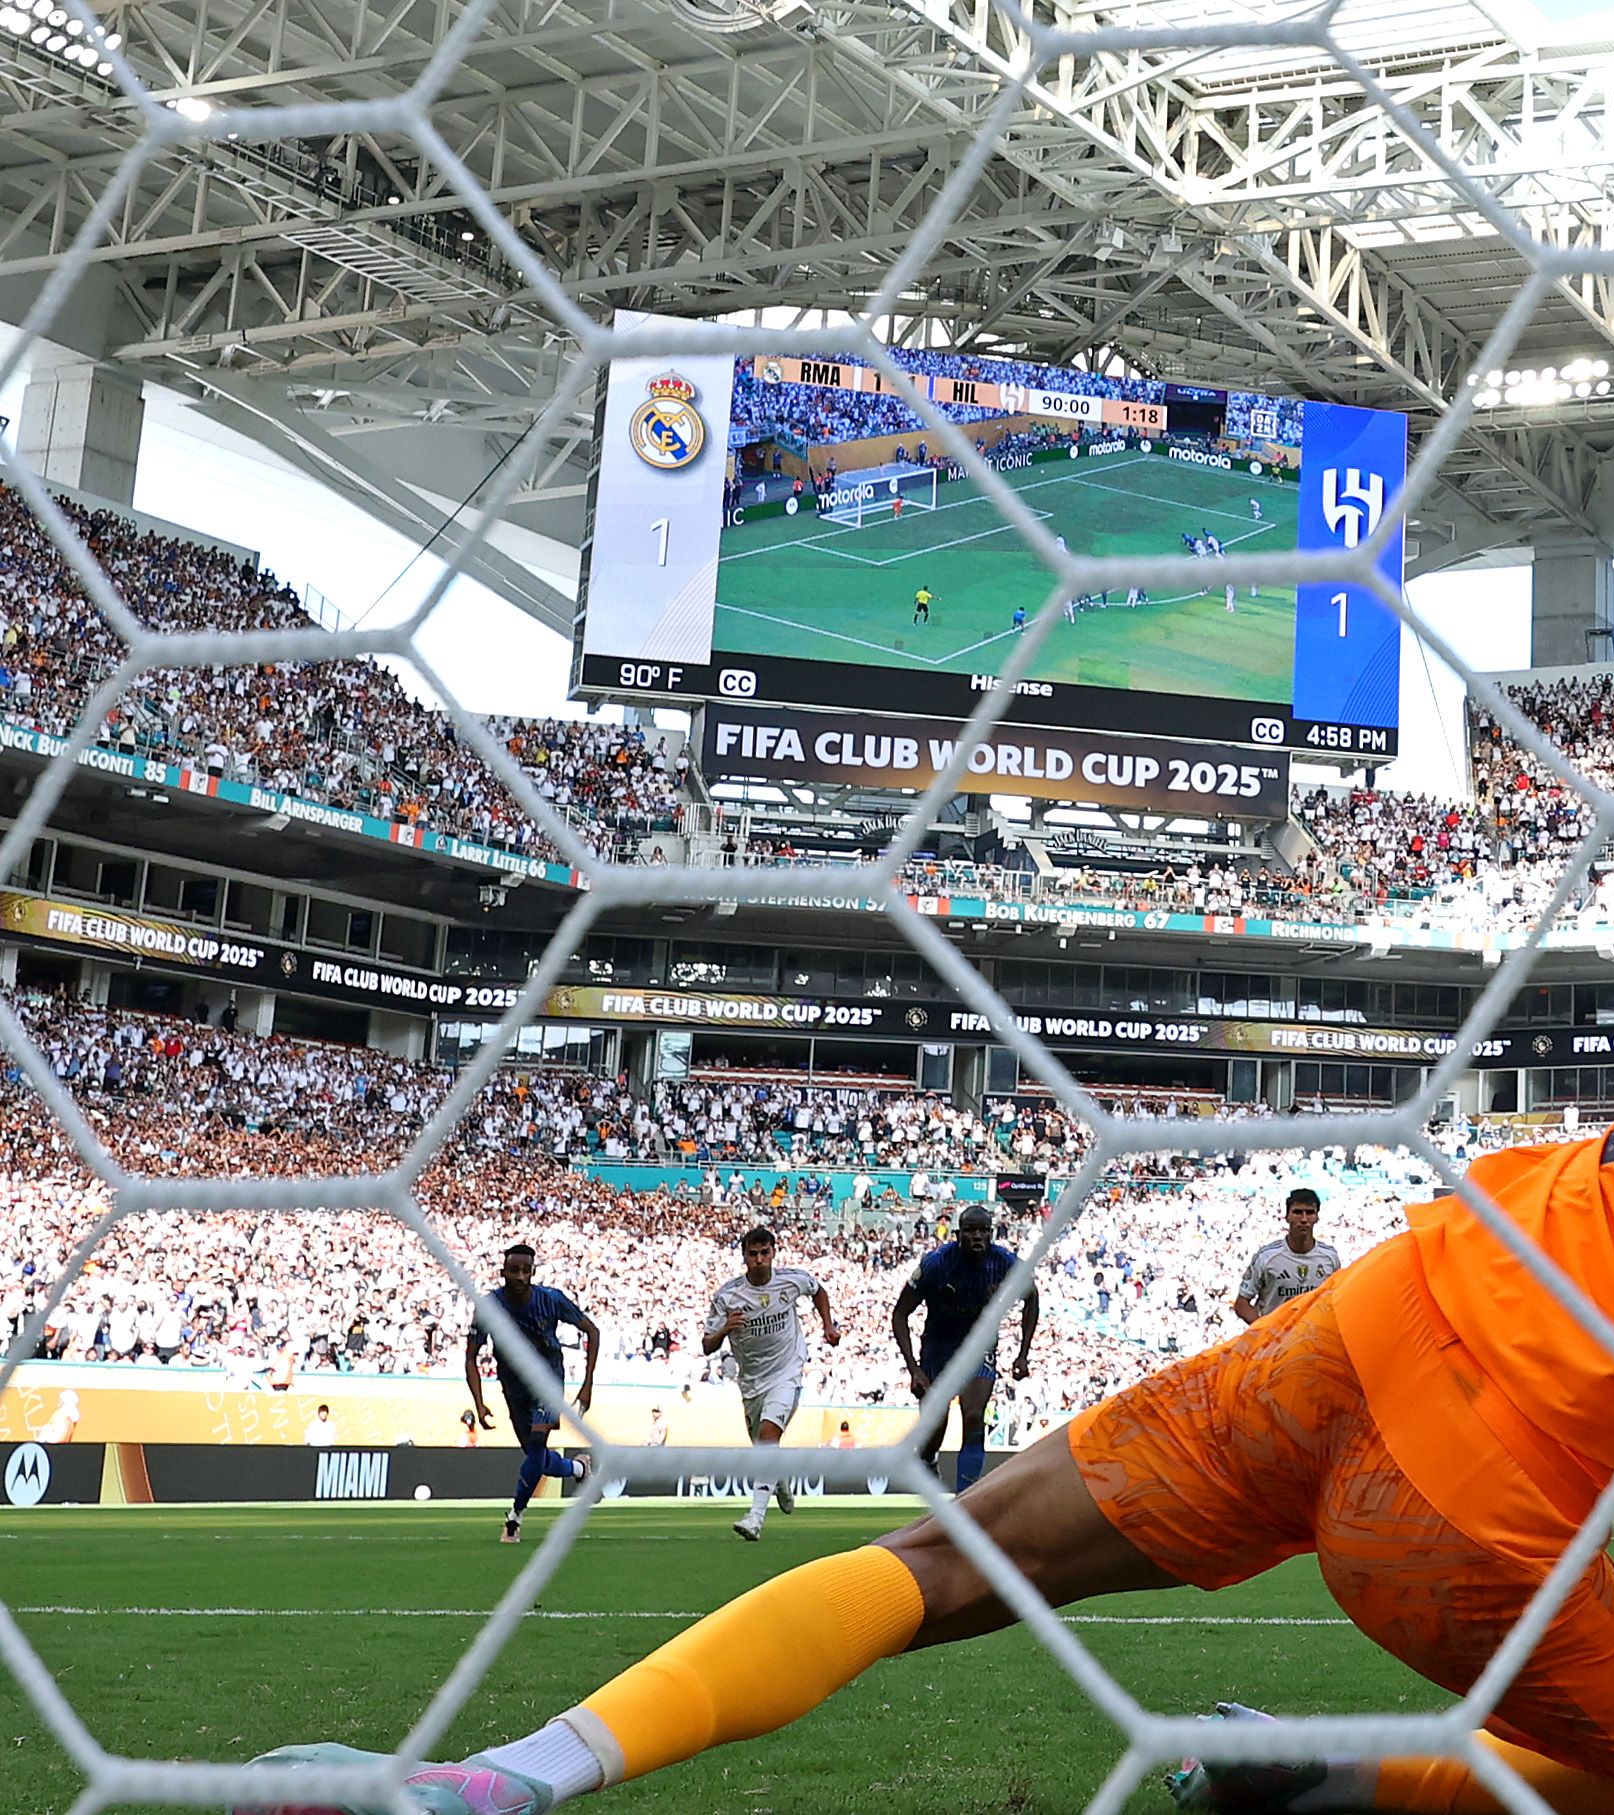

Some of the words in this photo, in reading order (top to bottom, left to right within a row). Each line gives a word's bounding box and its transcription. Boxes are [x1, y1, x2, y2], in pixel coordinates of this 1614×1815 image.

[801, 362, 841, 386] RMA
[953, 381, 978, 404] HIL
[1042, 396, 1090, 414] 90:00
[1123, 406, 1158, 424] 1:18
[1089, 439, 1125, 456] motorola
[1169, 447, 1231, 469] motorola
[818, 483, 874, 510] motorola
[650, 517, 670, 567] 1
[1331, 592, 1347, 638] 1
[668, 668, 683, 689] F
[723, 674, 751, 693] CC
[1255, 722, 1280, 739] CC
[1306, 725, 1352, 747] 4:58
[1359, 730, 1387, 751] PM
[715, 722, 806, 762] FIFA
[814, 732, 919, 770] CLUB
[928, 738, 1074, 781] WORLD
[1081, 752, 1160, 788] CUP
[143, 760, 167, 784] 85
[1054, 832, 1076, 849] JACK
[528, 858, 547, 879] 66
[48, 910, 83, 935] FIFA
[87, 918, 127, 942] CLUB
[130, 927, 186, 953] WORLD
[188, 939, 218, 958] CUP
[1144, 913, 1171, 930] 67
[313, 962, 341, 984] FIFA
[344, 969, 378, 990] CLUB
[381, 974, 427, 999] WORLD
[429, 985, 462, 1004] CUP
[602, 995, 645, 1014] FIFA
[650, 998, 700, 1016] CLUB
[707, 1002, 778, 1020] WORLD
[782, 1005, 821, 1023] CUP
[951, 1013, 990, 1031] FIFA
[994, 1015, 1041, 1034] UB
[1046, 1018, 1113, 1037] WORLD
[1115, 1022, 1152, 1039] CUP
[1271, 1031, 1308, 1047] FIFA
[1312, 1032, 1355, 1050] CLUB
[1359, 1035, 1420, 1053] WORLD
[1424, 1039, 1457, 1055] CUP
[1573, 1036, 1611, 1053] FIFA
[315, 1452, 389, 1498] MIAMI
